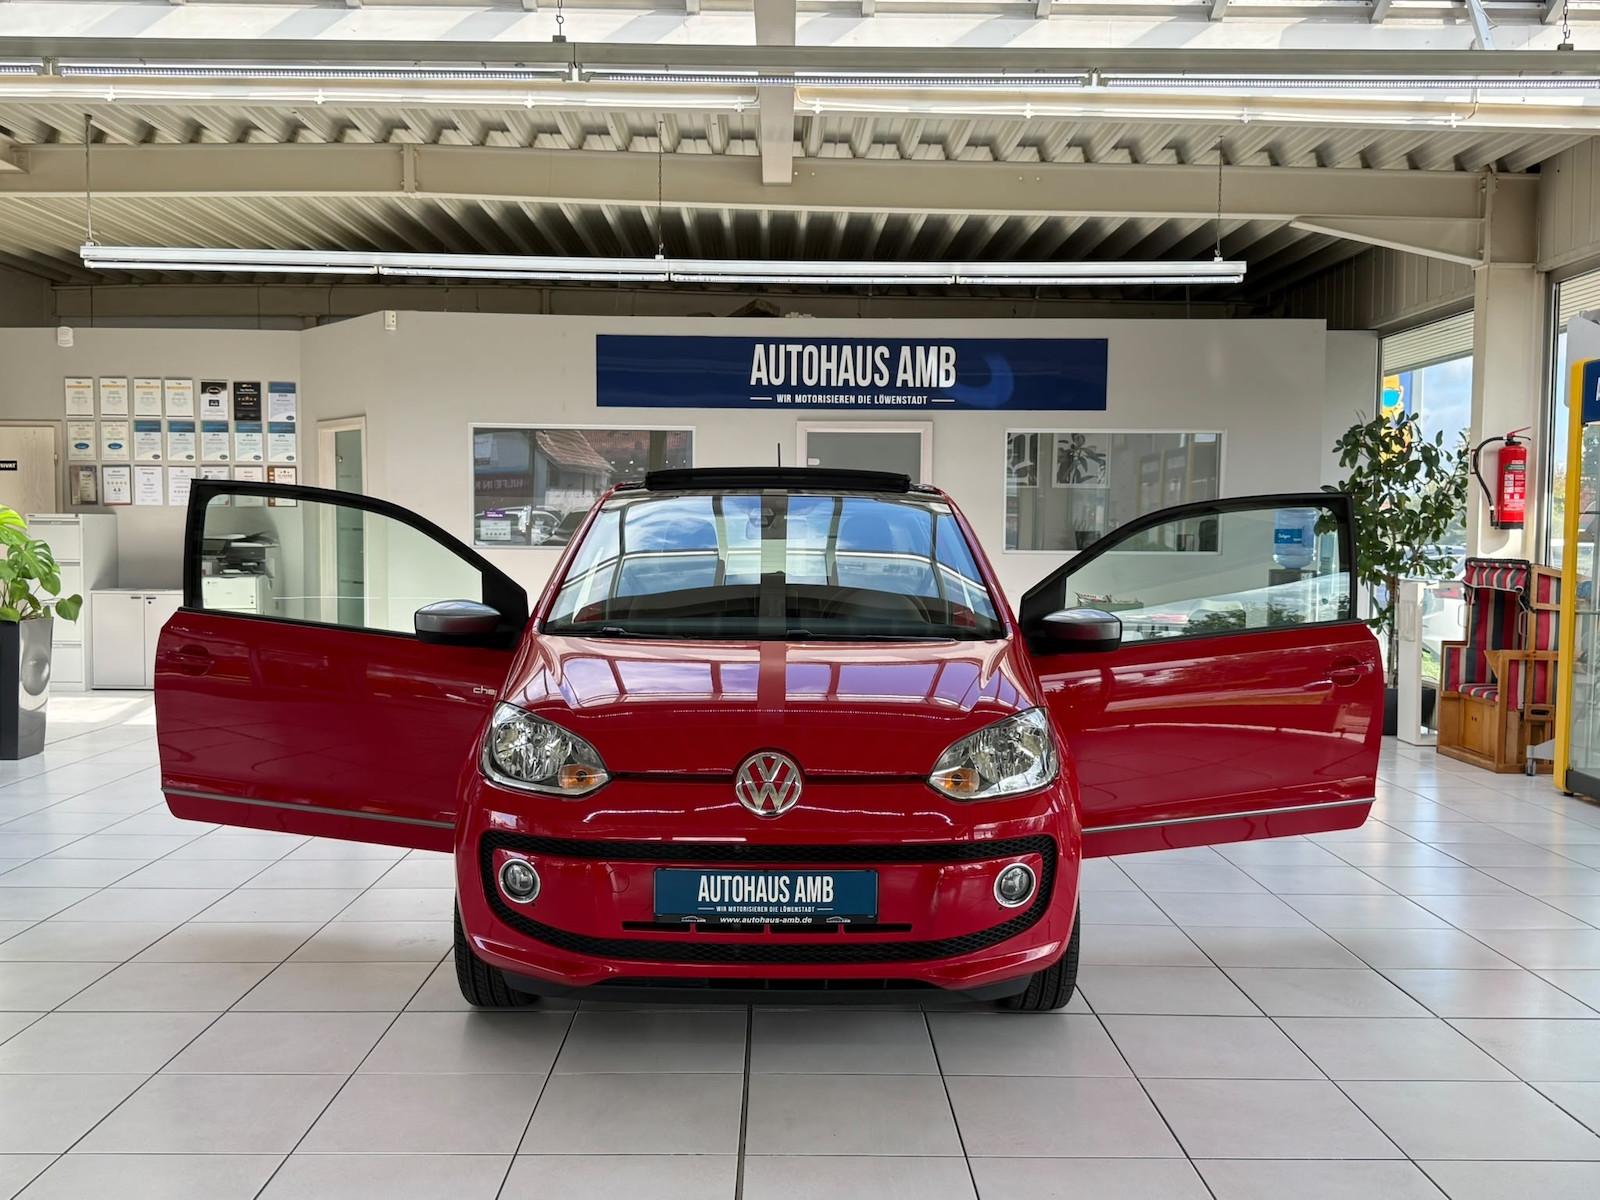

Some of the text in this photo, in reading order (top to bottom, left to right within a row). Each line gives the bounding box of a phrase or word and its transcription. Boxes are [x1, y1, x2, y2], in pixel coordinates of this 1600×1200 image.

[750, 344, 956, 388] AUTOHAUS AMB
[777, 394, 928, 404] WIR MOTORISIEREN DIE LÖWENSTADT
[697, 875, 834, 903] AUTOHAUS AMB
